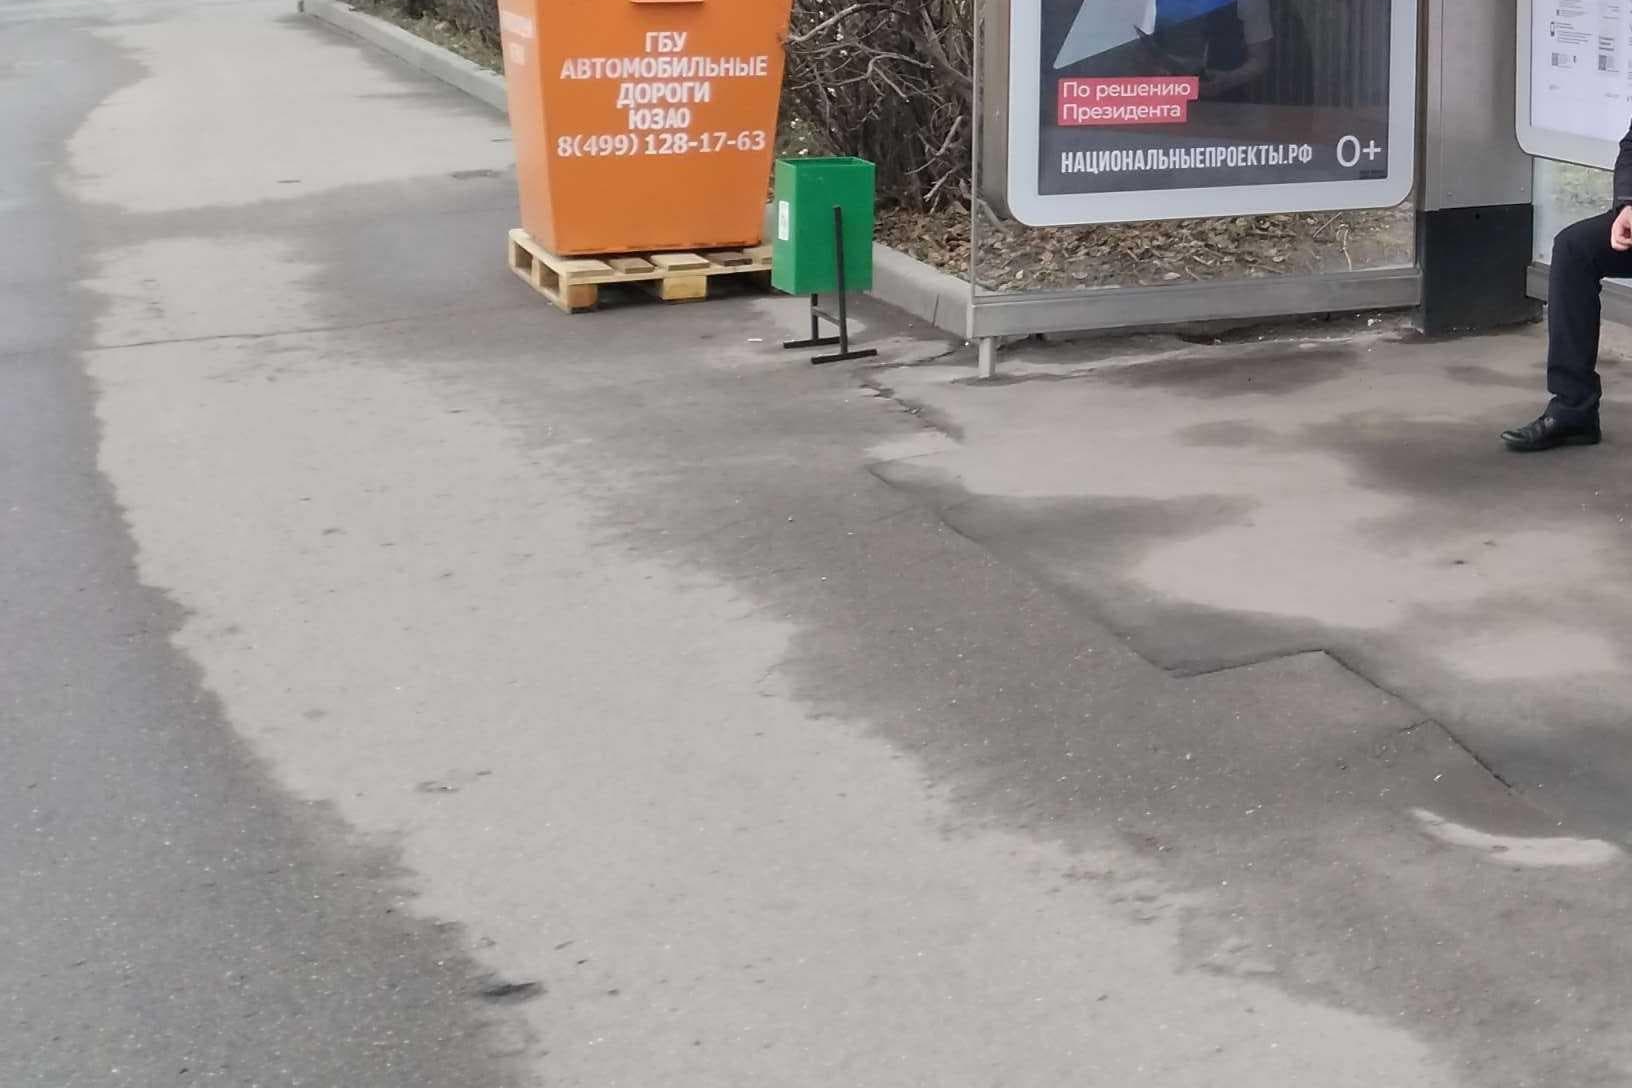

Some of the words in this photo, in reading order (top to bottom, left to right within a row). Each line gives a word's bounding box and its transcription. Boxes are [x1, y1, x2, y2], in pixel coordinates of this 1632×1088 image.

[644, 30, 688, 53] ГБУ
[559, 54, 769, 80] АВТОМОБИЛЬНЫЕ
[615, 80, 712, 109] ДОРОГИ
[1062, 81, 1091, 99] По
[1095, 81, 1191, 101] решению
[627, 107, 692, 130] ЮЗАО
[1062, 102, 1182, 123] Президента
[556, 133, 639, 157] 8(499)
[643, 129, 767, 155] 128-17-63
[1336, 134, 1382, 168] 0+
[1060, 143, 1313, 175] НАЦИОНАЛЬНЫЕПРОЕКТЫ.РФ
